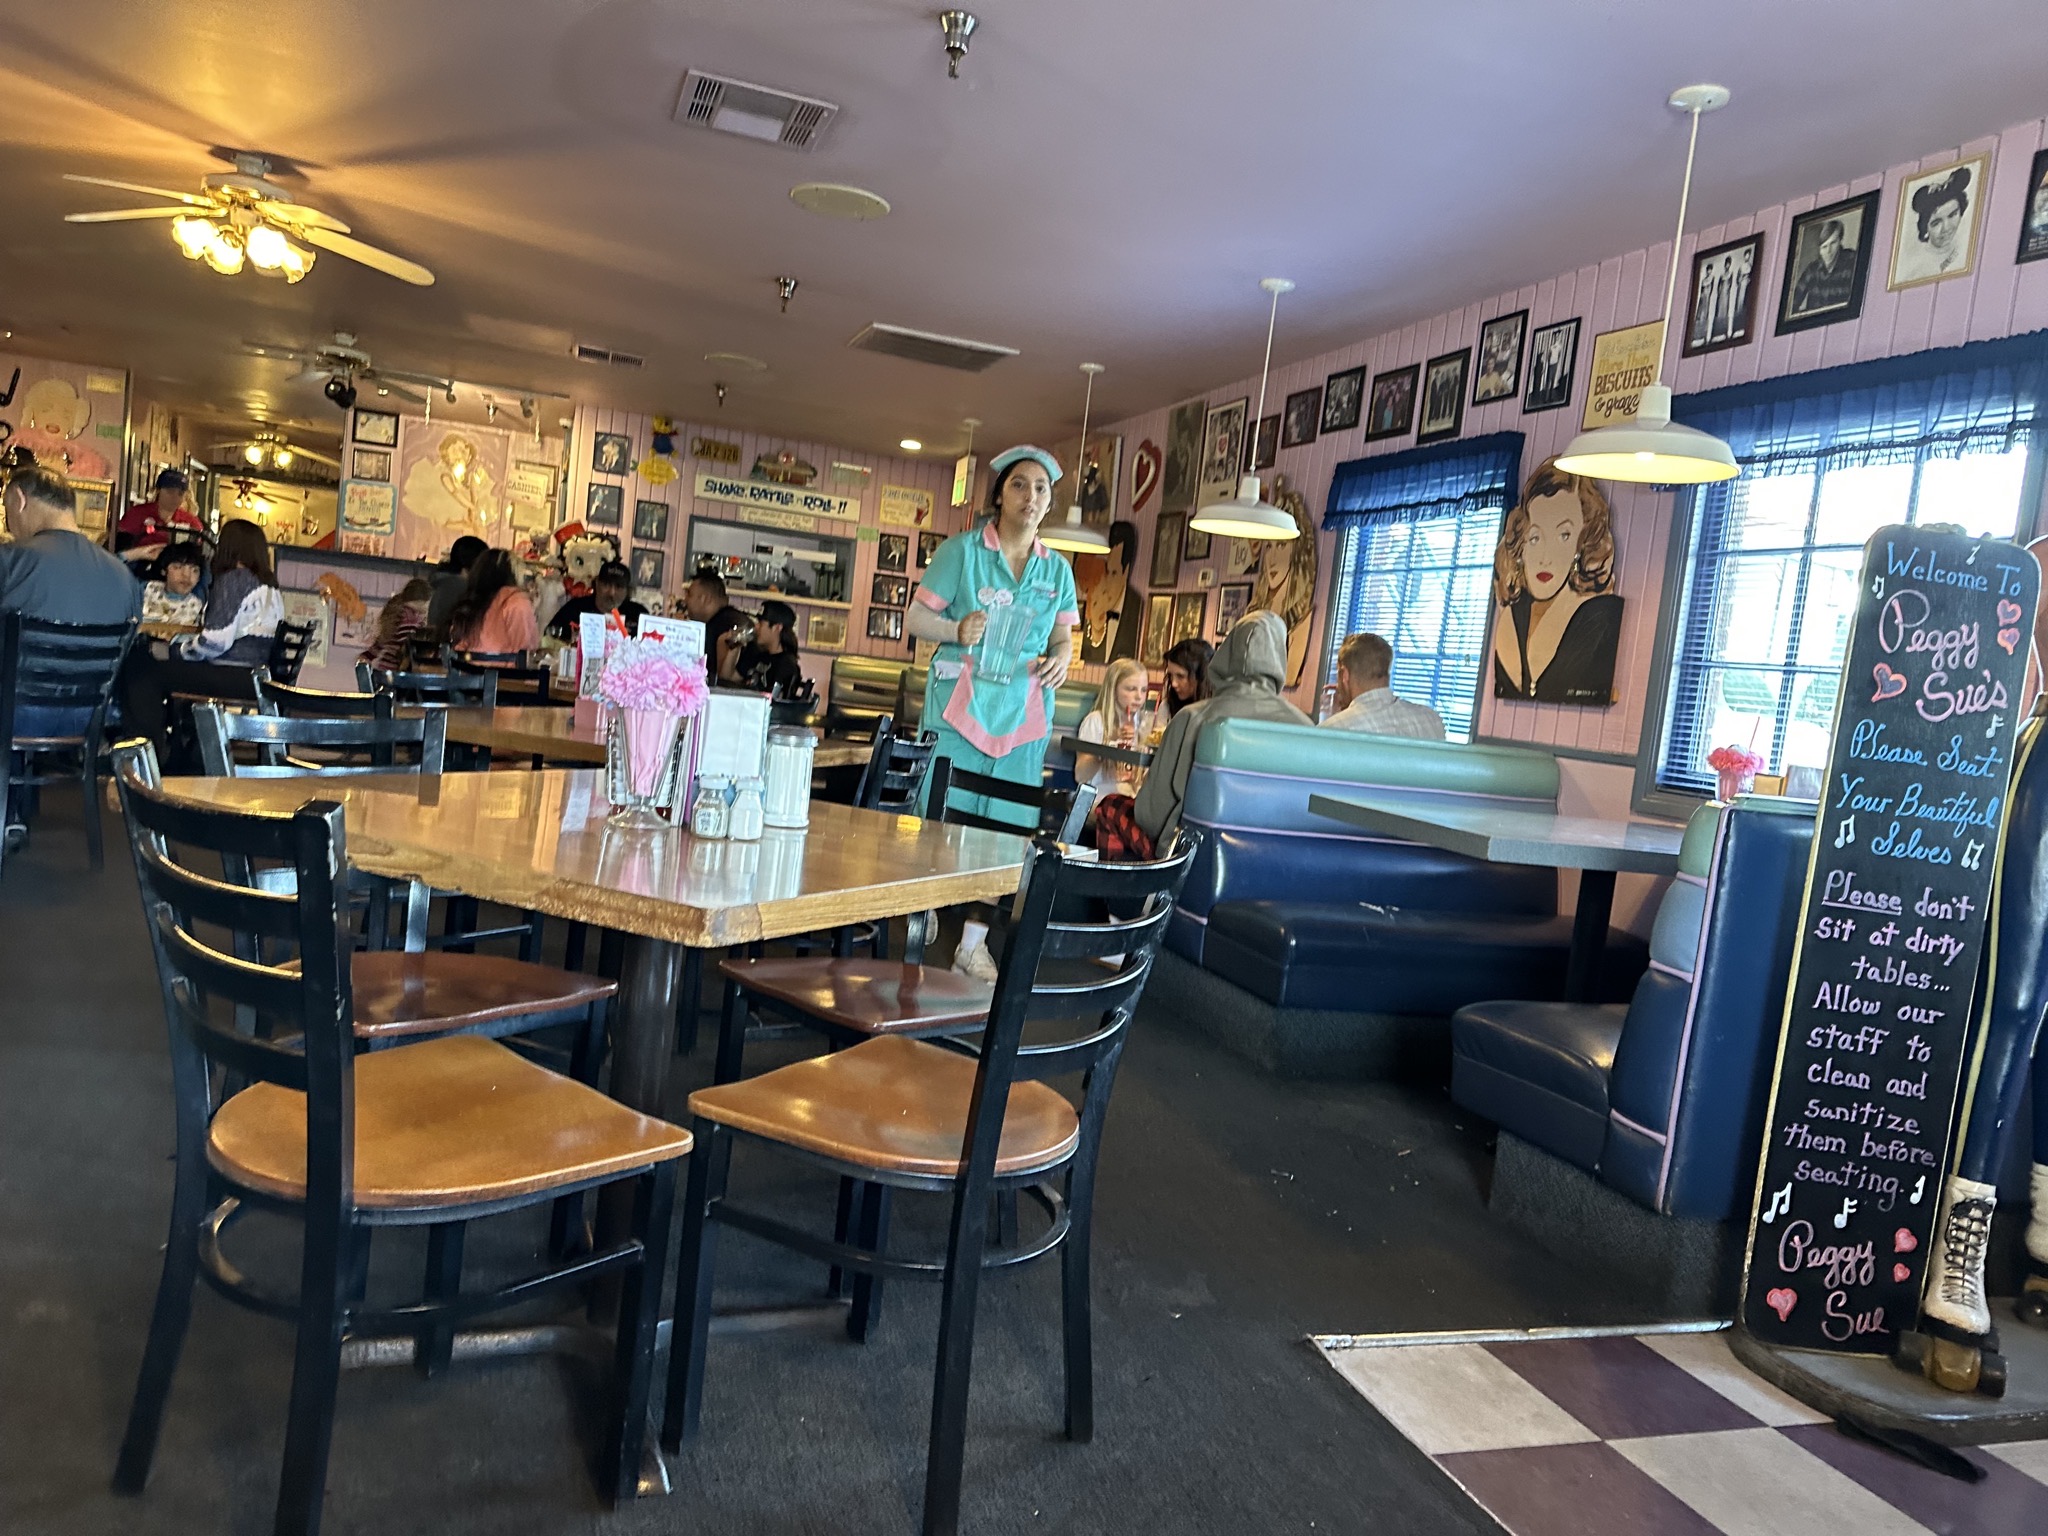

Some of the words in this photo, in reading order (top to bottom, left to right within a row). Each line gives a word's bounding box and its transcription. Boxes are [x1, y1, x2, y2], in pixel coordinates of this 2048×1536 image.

[1594, 364, 1654, 396] BISCUITS
[1594, 396, 1607, 413] &
[507, 480, 543, 496] CASHIER
[749, 486, 795, 506] RATTLE
[803, 495, 837, 513] ROLL
[1887, 541, 1988, 592] Welcome
[1996, 563, 2022, 597] To
[1879, 588, 1980, 670] Peggy
[1915, 668, 2009, 722] Sue's
[1849, 718, 1928, 767] Please
[1936, 735, 2003, 778] Seat
[1836, 772, 1893, 815] Your
[1894, 782, 2000, 838] Beautiful
[1871, 821, 1952, 864] Selves
[1822, 869, 1903, 912] Please
[1913, 887, 1976, 921] don't
[1869, 923, 1901, 948] at
[1905, 927, 1966, 966] dirty
[1851, 955, 1951, 993] tables...
[1812, 981, 1882, 1016] Allow
[1897, 1004, 1946, 1024] our
[1805, 1024, 1891, 1058] staff
[1905, 1033, 1932, 1063] to
[1806, 1058, 1871, 1091] clean
[1886, 1071, 1927, 1101] and
[1783, 1124, 1847, 1156] them
[1860, 1131, 1937, 1169] before
[1778, 1219, 1877, 1287] Peggy
[1821, 1290, 1890, 1341] Sue
